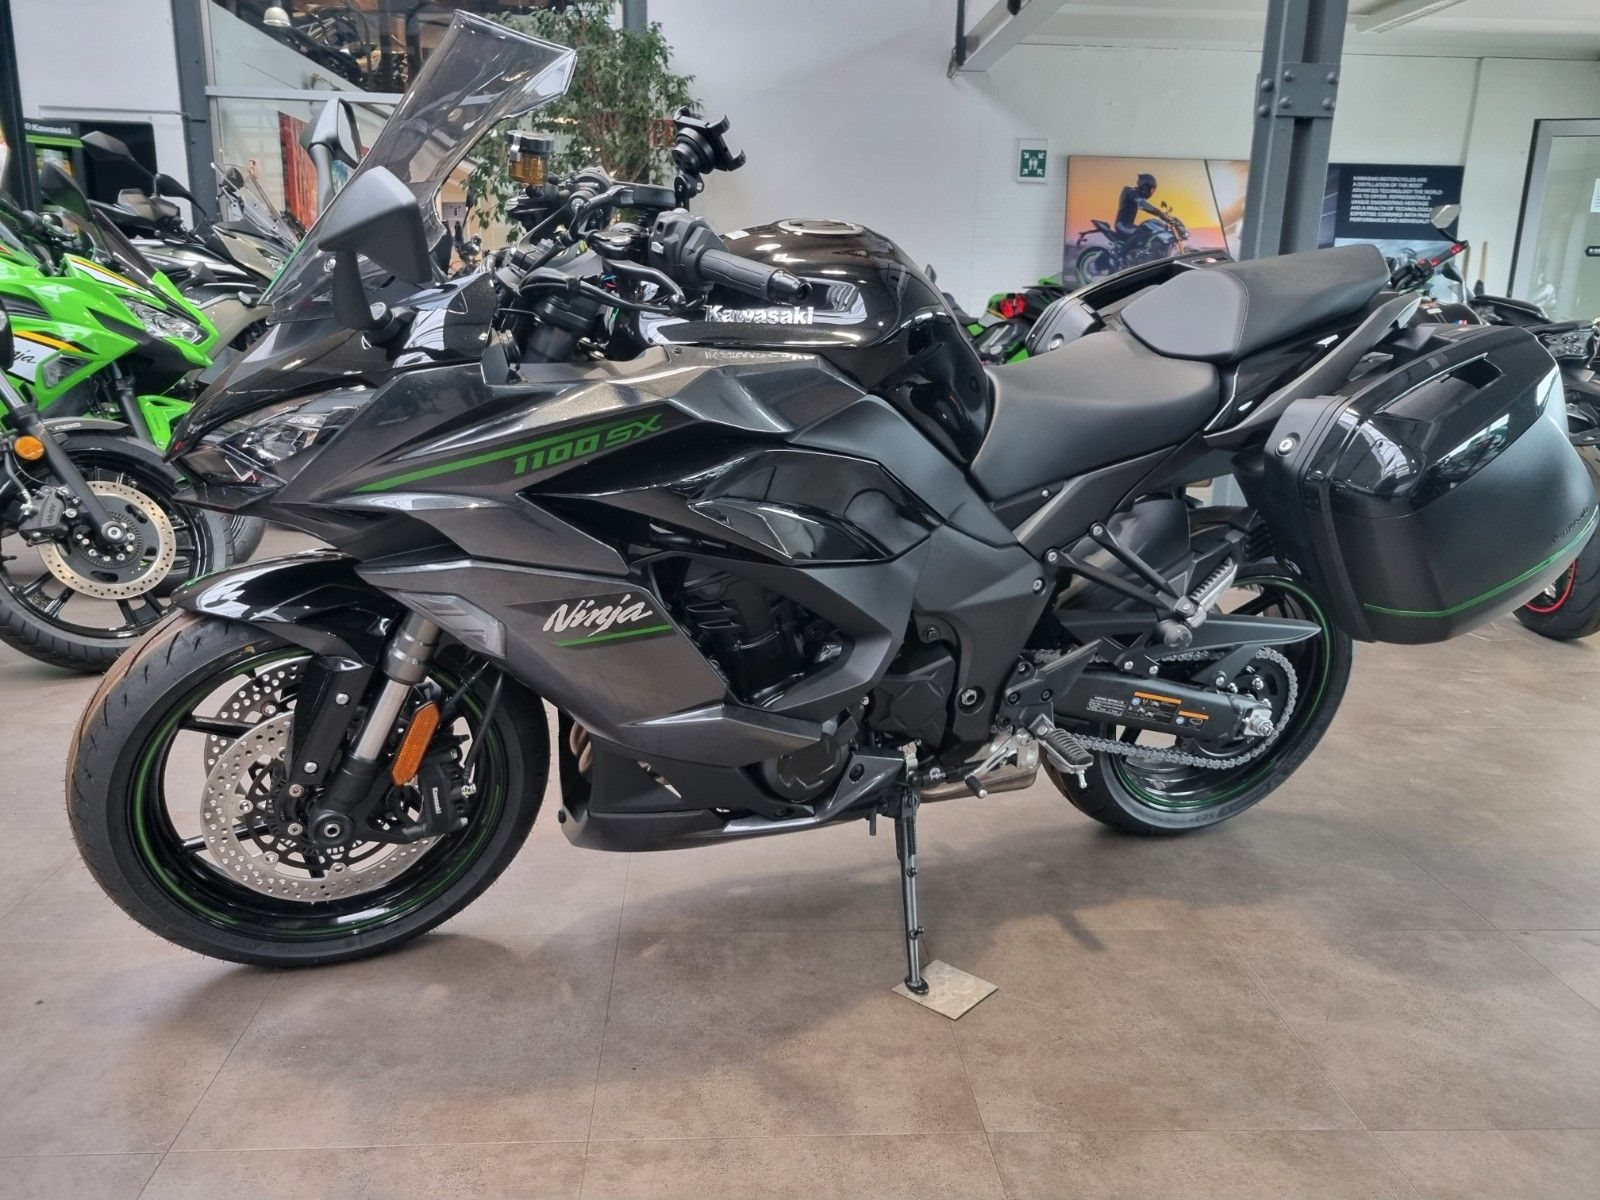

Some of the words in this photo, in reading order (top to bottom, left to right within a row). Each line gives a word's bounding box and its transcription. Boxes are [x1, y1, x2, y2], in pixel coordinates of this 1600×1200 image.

[31, 123, 72, 134] Kawasaki
[703, 304, 814, 324] Kawasaki
[514, 433, 600, 475] 1100
[605, 413, 662, 448] SX
[542, 593, 653, 637] Ninja
